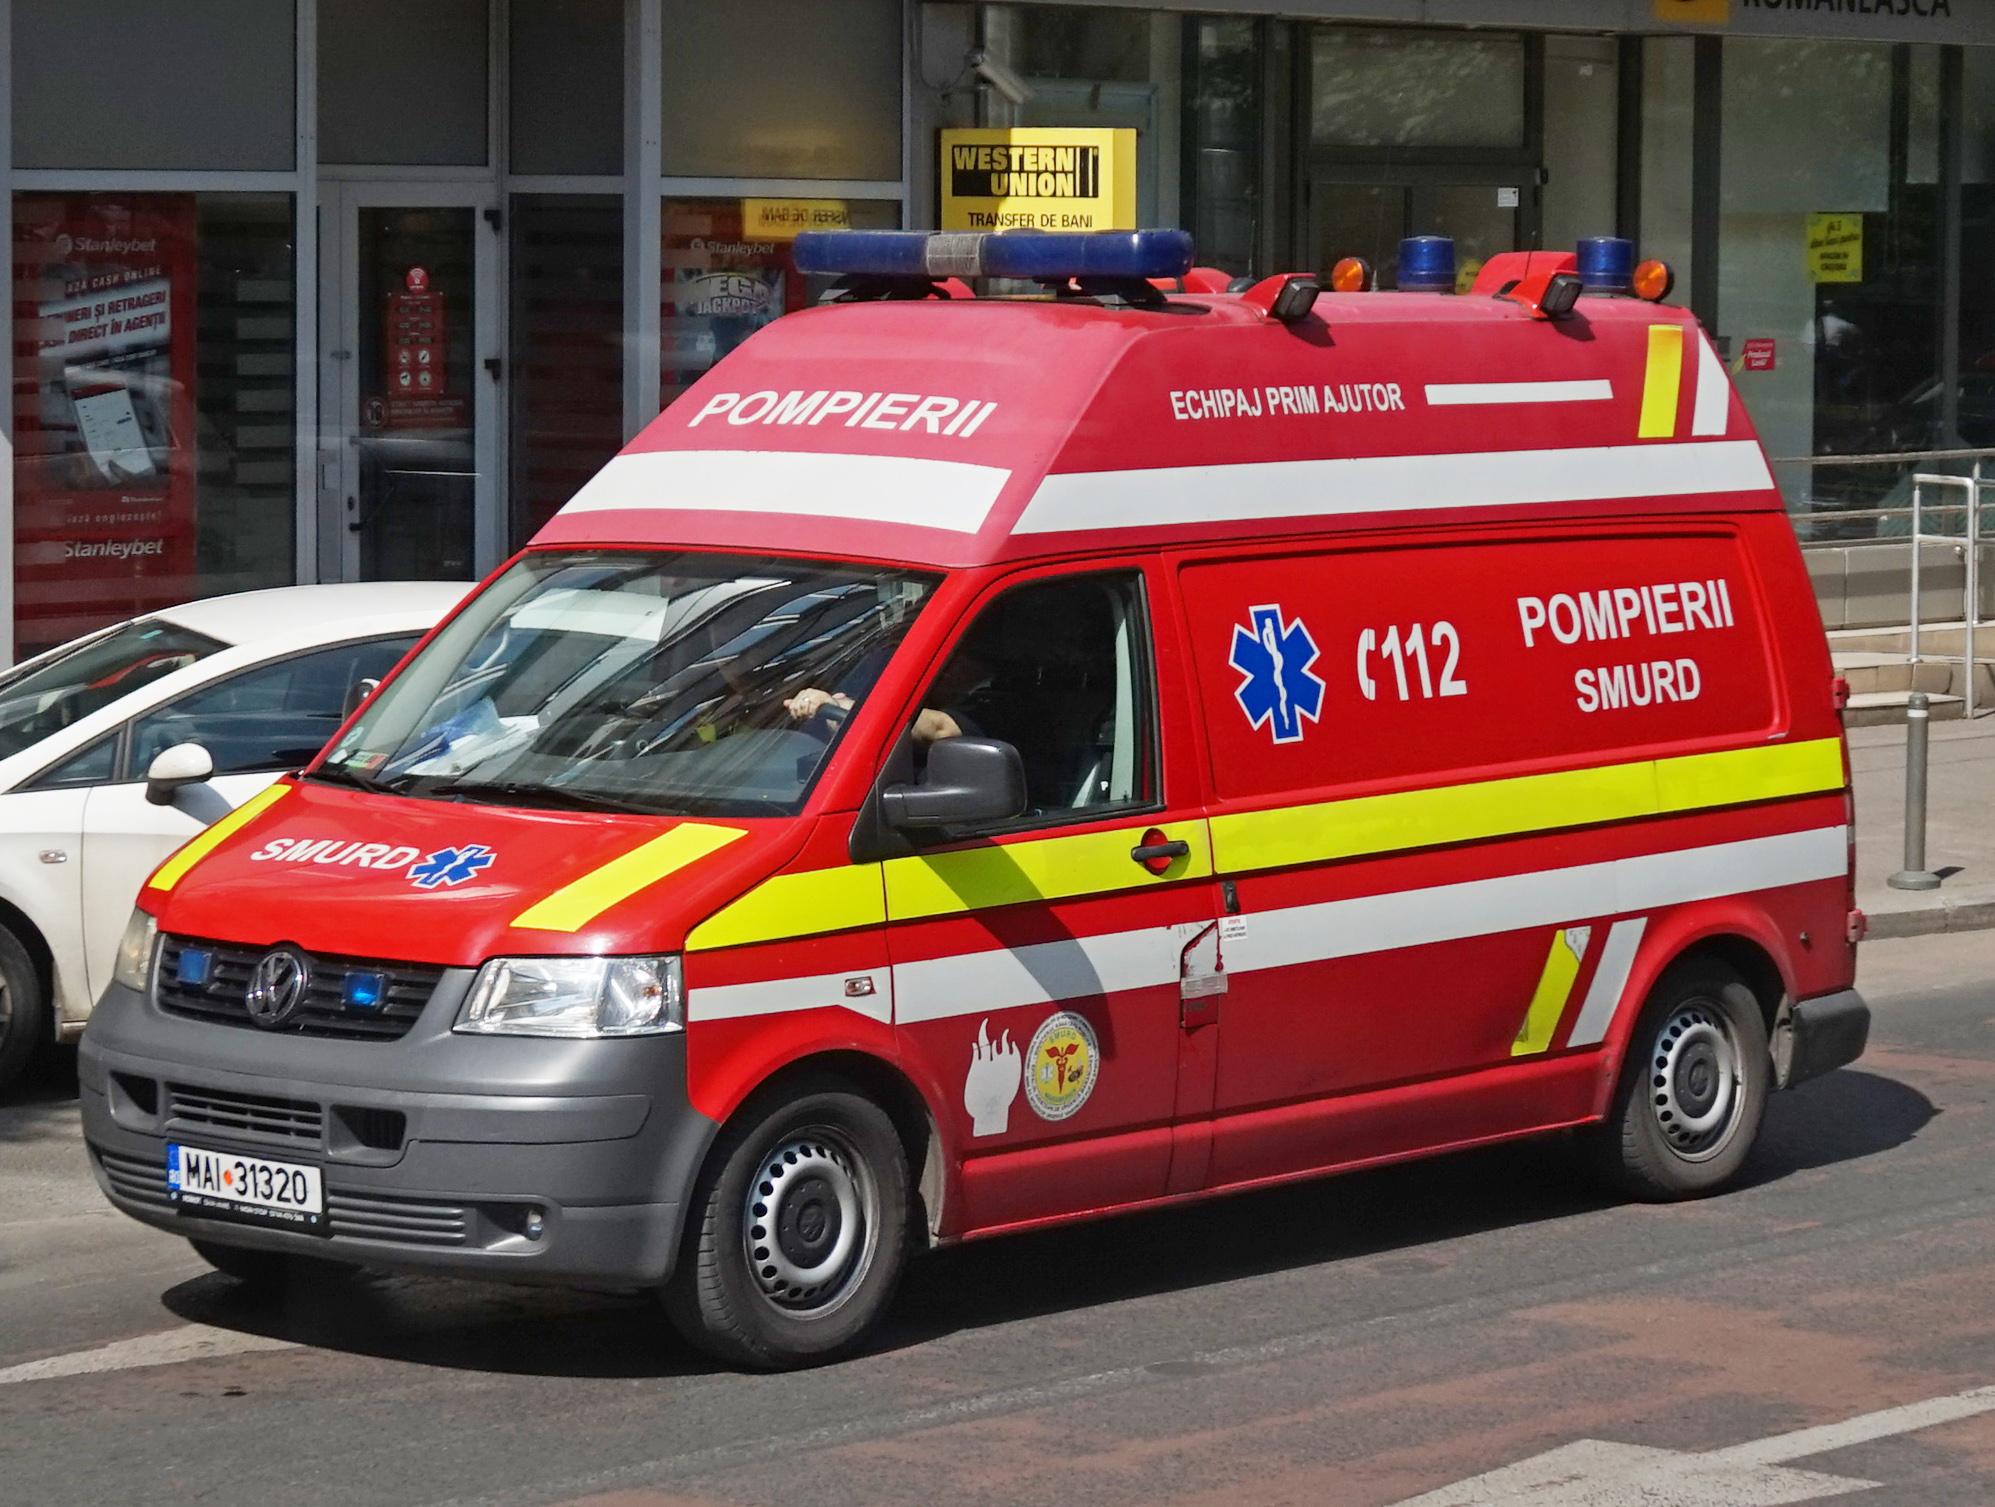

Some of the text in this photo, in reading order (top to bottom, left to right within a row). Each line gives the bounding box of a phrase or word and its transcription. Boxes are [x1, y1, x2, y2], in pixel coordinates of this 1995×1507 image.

[953, 147, 1075, 171] WESTERN
[990, 173, 1075, 197] UNION
[968, 212, 1093, 228] TRANSFER DE BANI
[74, 236, 156, 253] Stanleybet
[707, 240, 775, 256] Stanleybet
[68, 324, 108, 343] DIRECT
[688, 390, 998, 437] POMPIERII
[1170, 383, 1405, 420] ECHIPAJ PRIM AJUTOR
[65, 539, 164, 560] Stanleybet
[1518, 579, 1735, 648] POMPIERII
[1381, 621, 1467, 701] 112
[1575, 659, 1701, 712] SMURD
[250, 838, 420, 869] SMURD
[186, 1153, 307, 1205] MAI 31320
